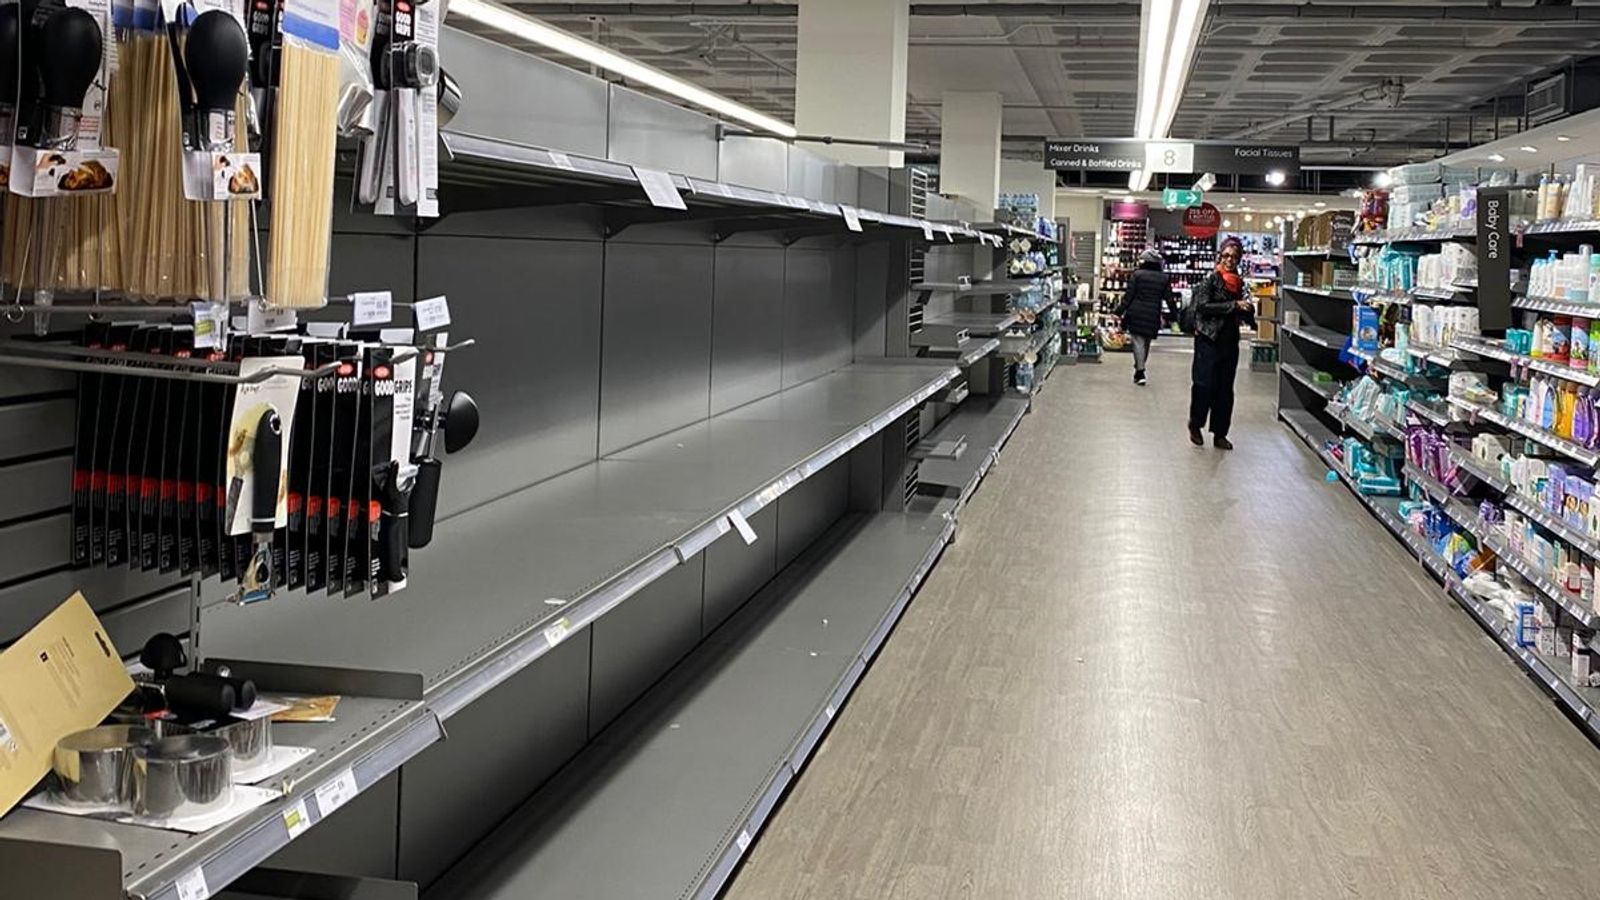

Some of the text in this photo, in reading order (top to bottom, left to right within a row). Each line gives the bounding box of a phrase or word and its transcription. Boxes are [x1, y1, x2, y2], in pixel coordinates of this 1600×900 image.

[395, 10, 411, 26] GOOD
[394, 22, 411, 37] GRIPS
[1049, 144, 1099, 153] Mixer Drinks
[1234, 147, 1292, 158] Facial Tissues
[1050, 158, 1142, 169] Canned & Bottled Drinks
[1164, 149, 1176, 166] 8
[1485, 200, 1500, 259] Baby Care
[374, 379, 395, 397] GOOD
